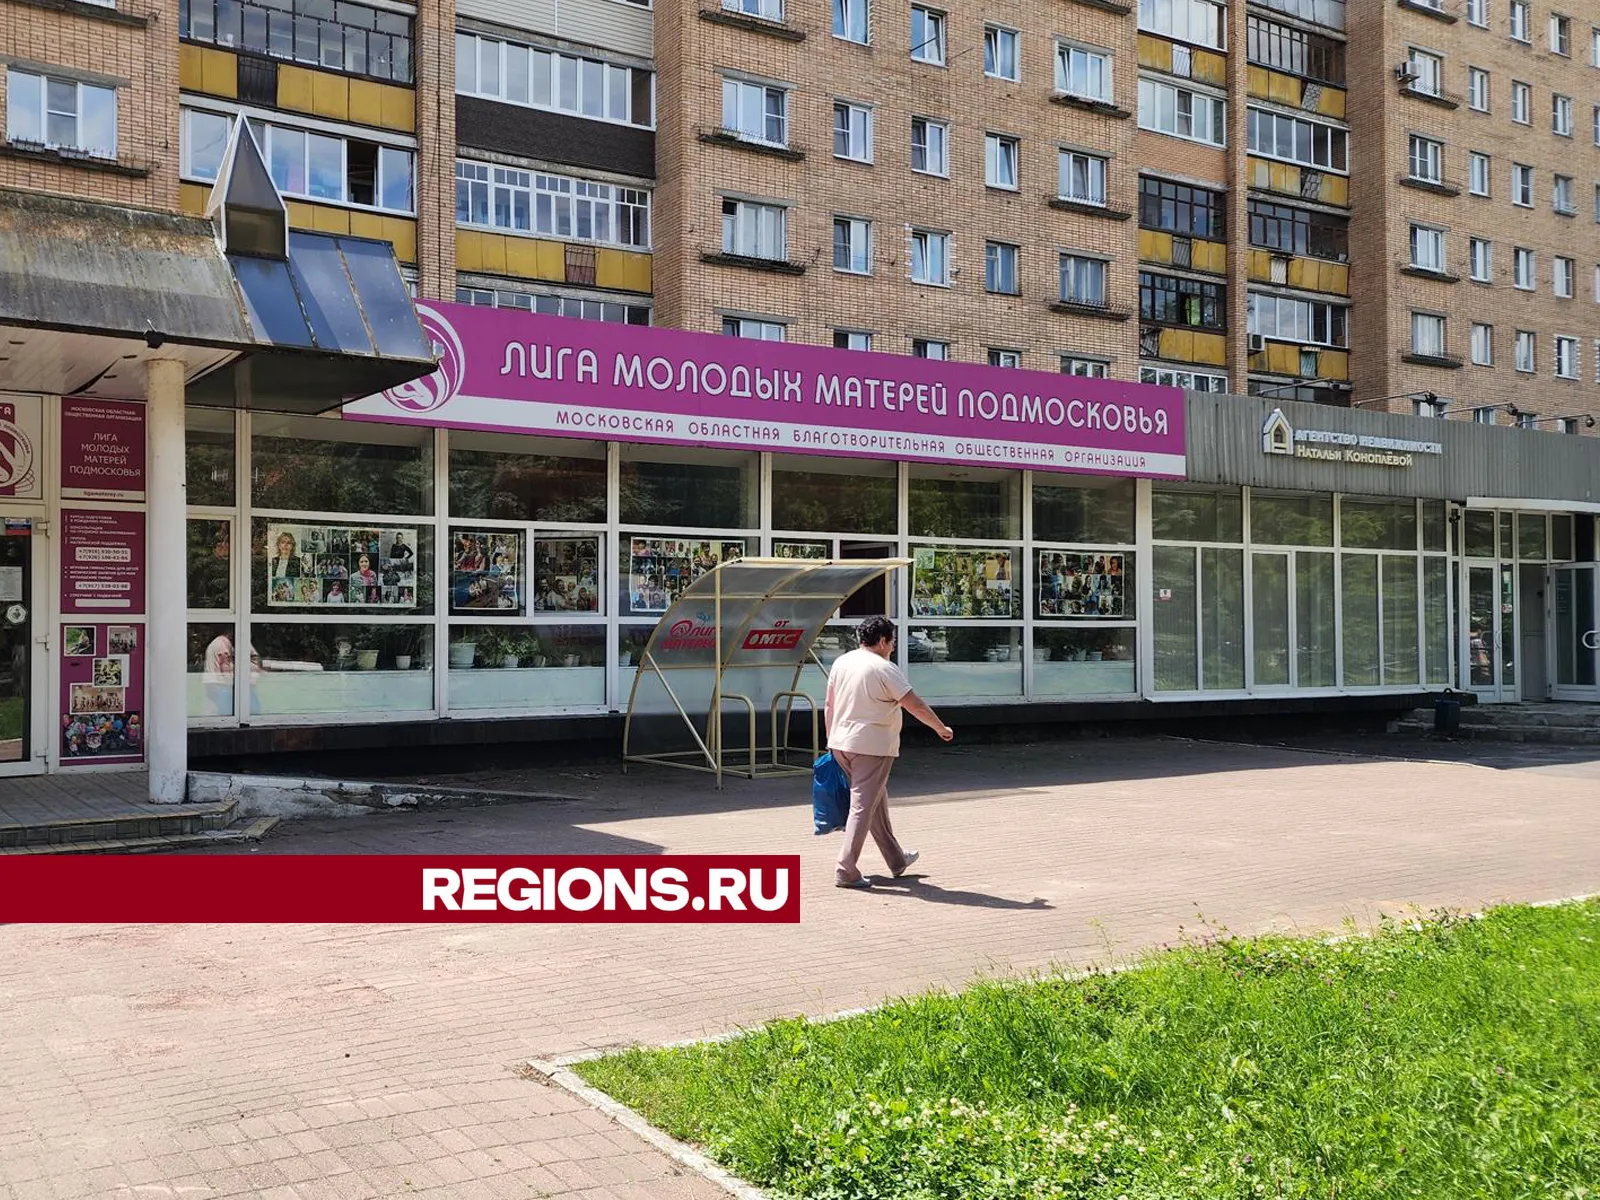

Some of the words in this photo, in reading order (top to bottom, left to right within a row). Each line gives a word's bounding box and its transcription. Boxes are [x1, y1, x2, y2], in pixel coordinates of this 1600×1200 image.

[500, 339, 599, 384] ЛИГА
[612, 351, 803, 403] МОЛОДЫХ
[814, 372, 948, 417] МАТЕРЕЙ
[957, 389, 1169, 436] ПОДМОСКОВЬЯ
[93, 433, 119, 442] ЛИГА
[556, 410, 674, 433] МОСКОВСКАЯ
[688, 421, 780, 441] ОБЛАСТНАЯ
[793, 429, 945, 453] БЛАГОТВОРИТЕЛЬНАЯ
[955, 442, 1054, 461] ОБЩЕСТВЕННАЯ
[1064, 450, 1146, 468] ОРГАНИЗАЦИЯ
[1294, 429, 1358, 446] АГЕНТСТВО
[1358, 435, 1442, 453] НЕДВИЖИМОСТИ
[81, 444, 131, 455] МОЛОДЫХ
[84, 456, 128, 466] МАТЕРЕЙ
[69, 466, 142, 478] ПОДМОСКОВЬЯ
